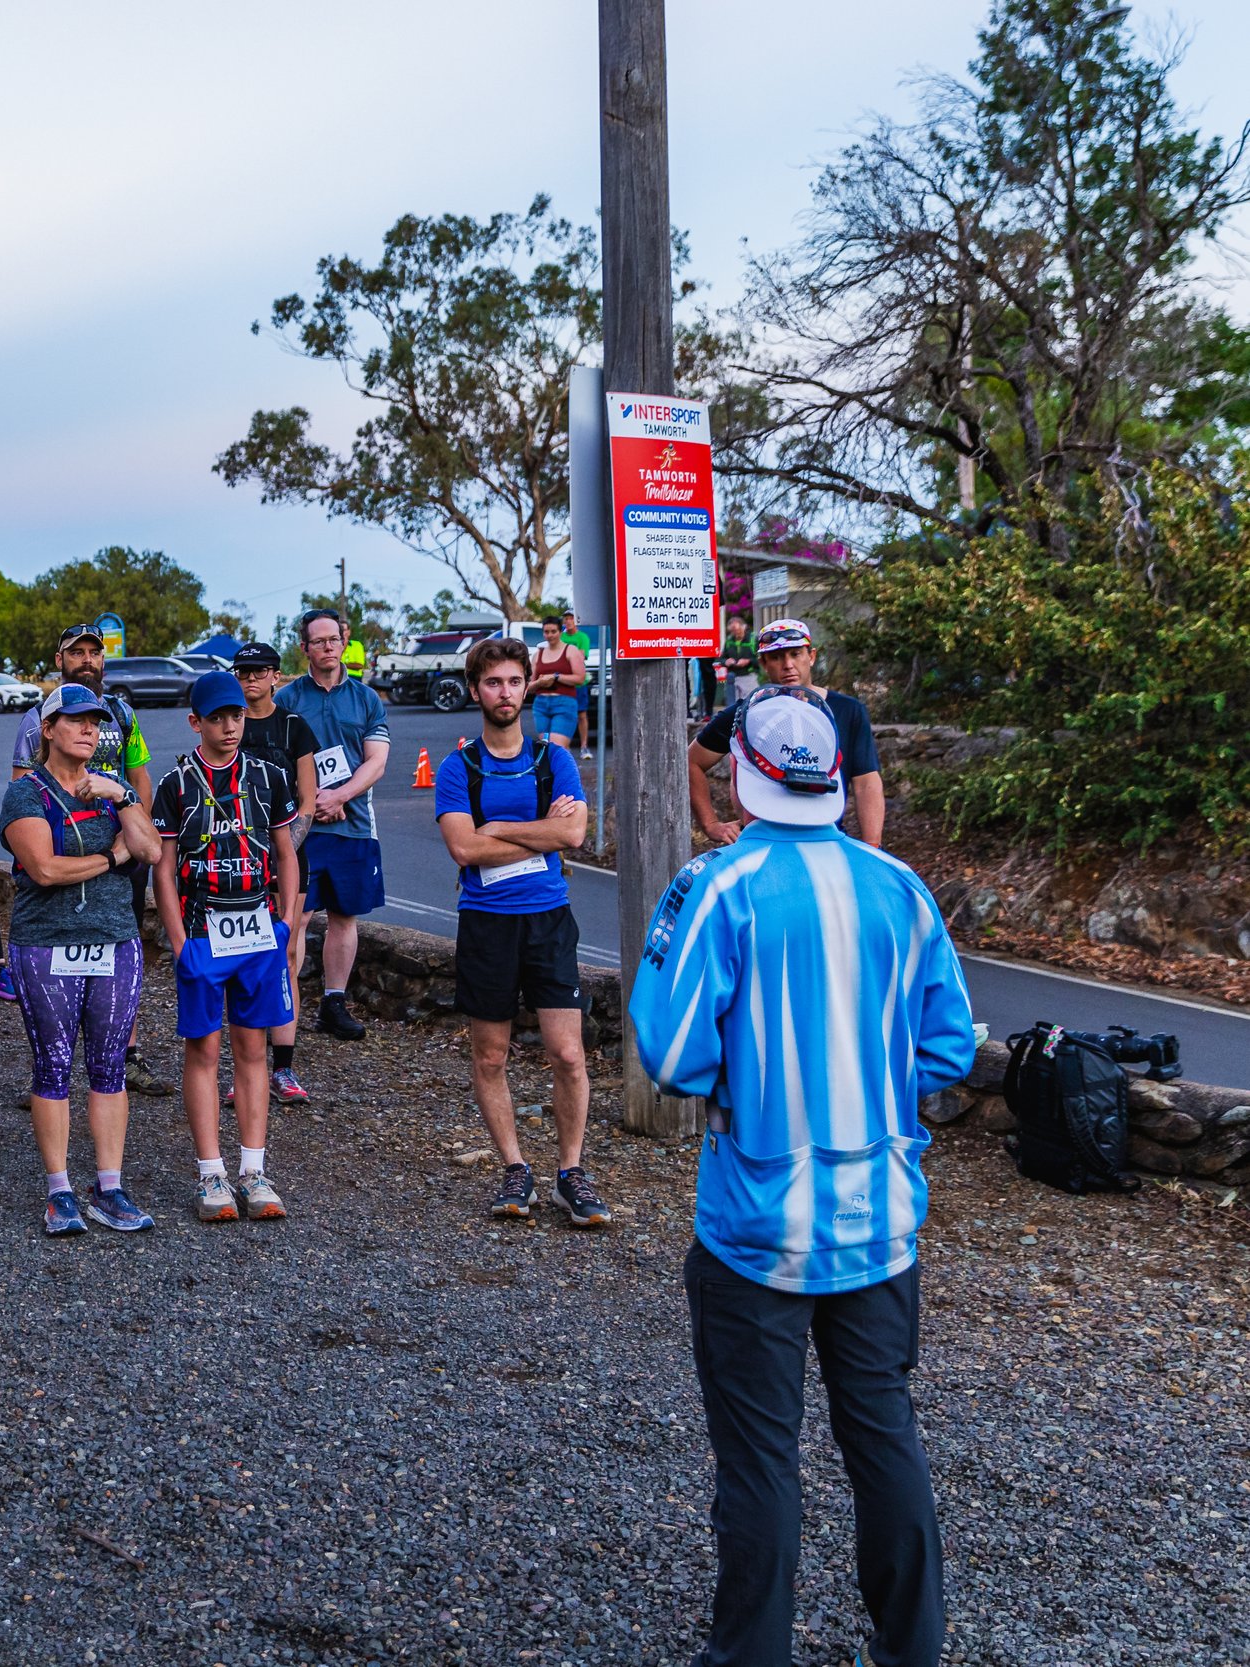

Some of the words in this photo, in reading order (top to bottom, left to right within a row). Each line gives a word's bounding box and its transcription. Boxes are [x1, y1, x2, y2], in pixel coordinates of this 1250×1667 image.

[634, 403, 701, 425] INTERSPORT
[643, 423, 687, 438] TAMWORTH
[638, 468, 697, 483] TAMWORTH
[644, 481, 694, 502] Trailblazer
[628, 510, 680, 523] COMMUNITY
[681, 513, 708, 525] NOTICE
[646, 533, 673, 543] SHARED
[675, 534, 687, 544] USE
[688, 535, 696, 543] OF
[633, 547, 672, 556] FLAGSTAFF
[673, 548, 694, 557] TRAILS
[695, 549, 706, 558] FOR
[656, 561, 675, 570] TRAIL
[676, 562, 689, 570] RUN
[653, 576, 693, 589] SUNDAY
[631, 596, 646, 609] 22
[648, 596, 687, 609] MARCH
[688, 597, 710, 609] 2026
[646, 611, 669, 623] 6am
[677, 611, 699, 626] 6pm
[629, 637, 714, 648] tamworthtrailblazer.com
[780, 744, 798, 757] Pro
[318, 757, 337, 776] 19
[788, 755, 819, 764] Active
[189, 857, 262, 873] FINESTR
[218, 914, 261, 939] 014
[64, 943, 105, 962] 013
